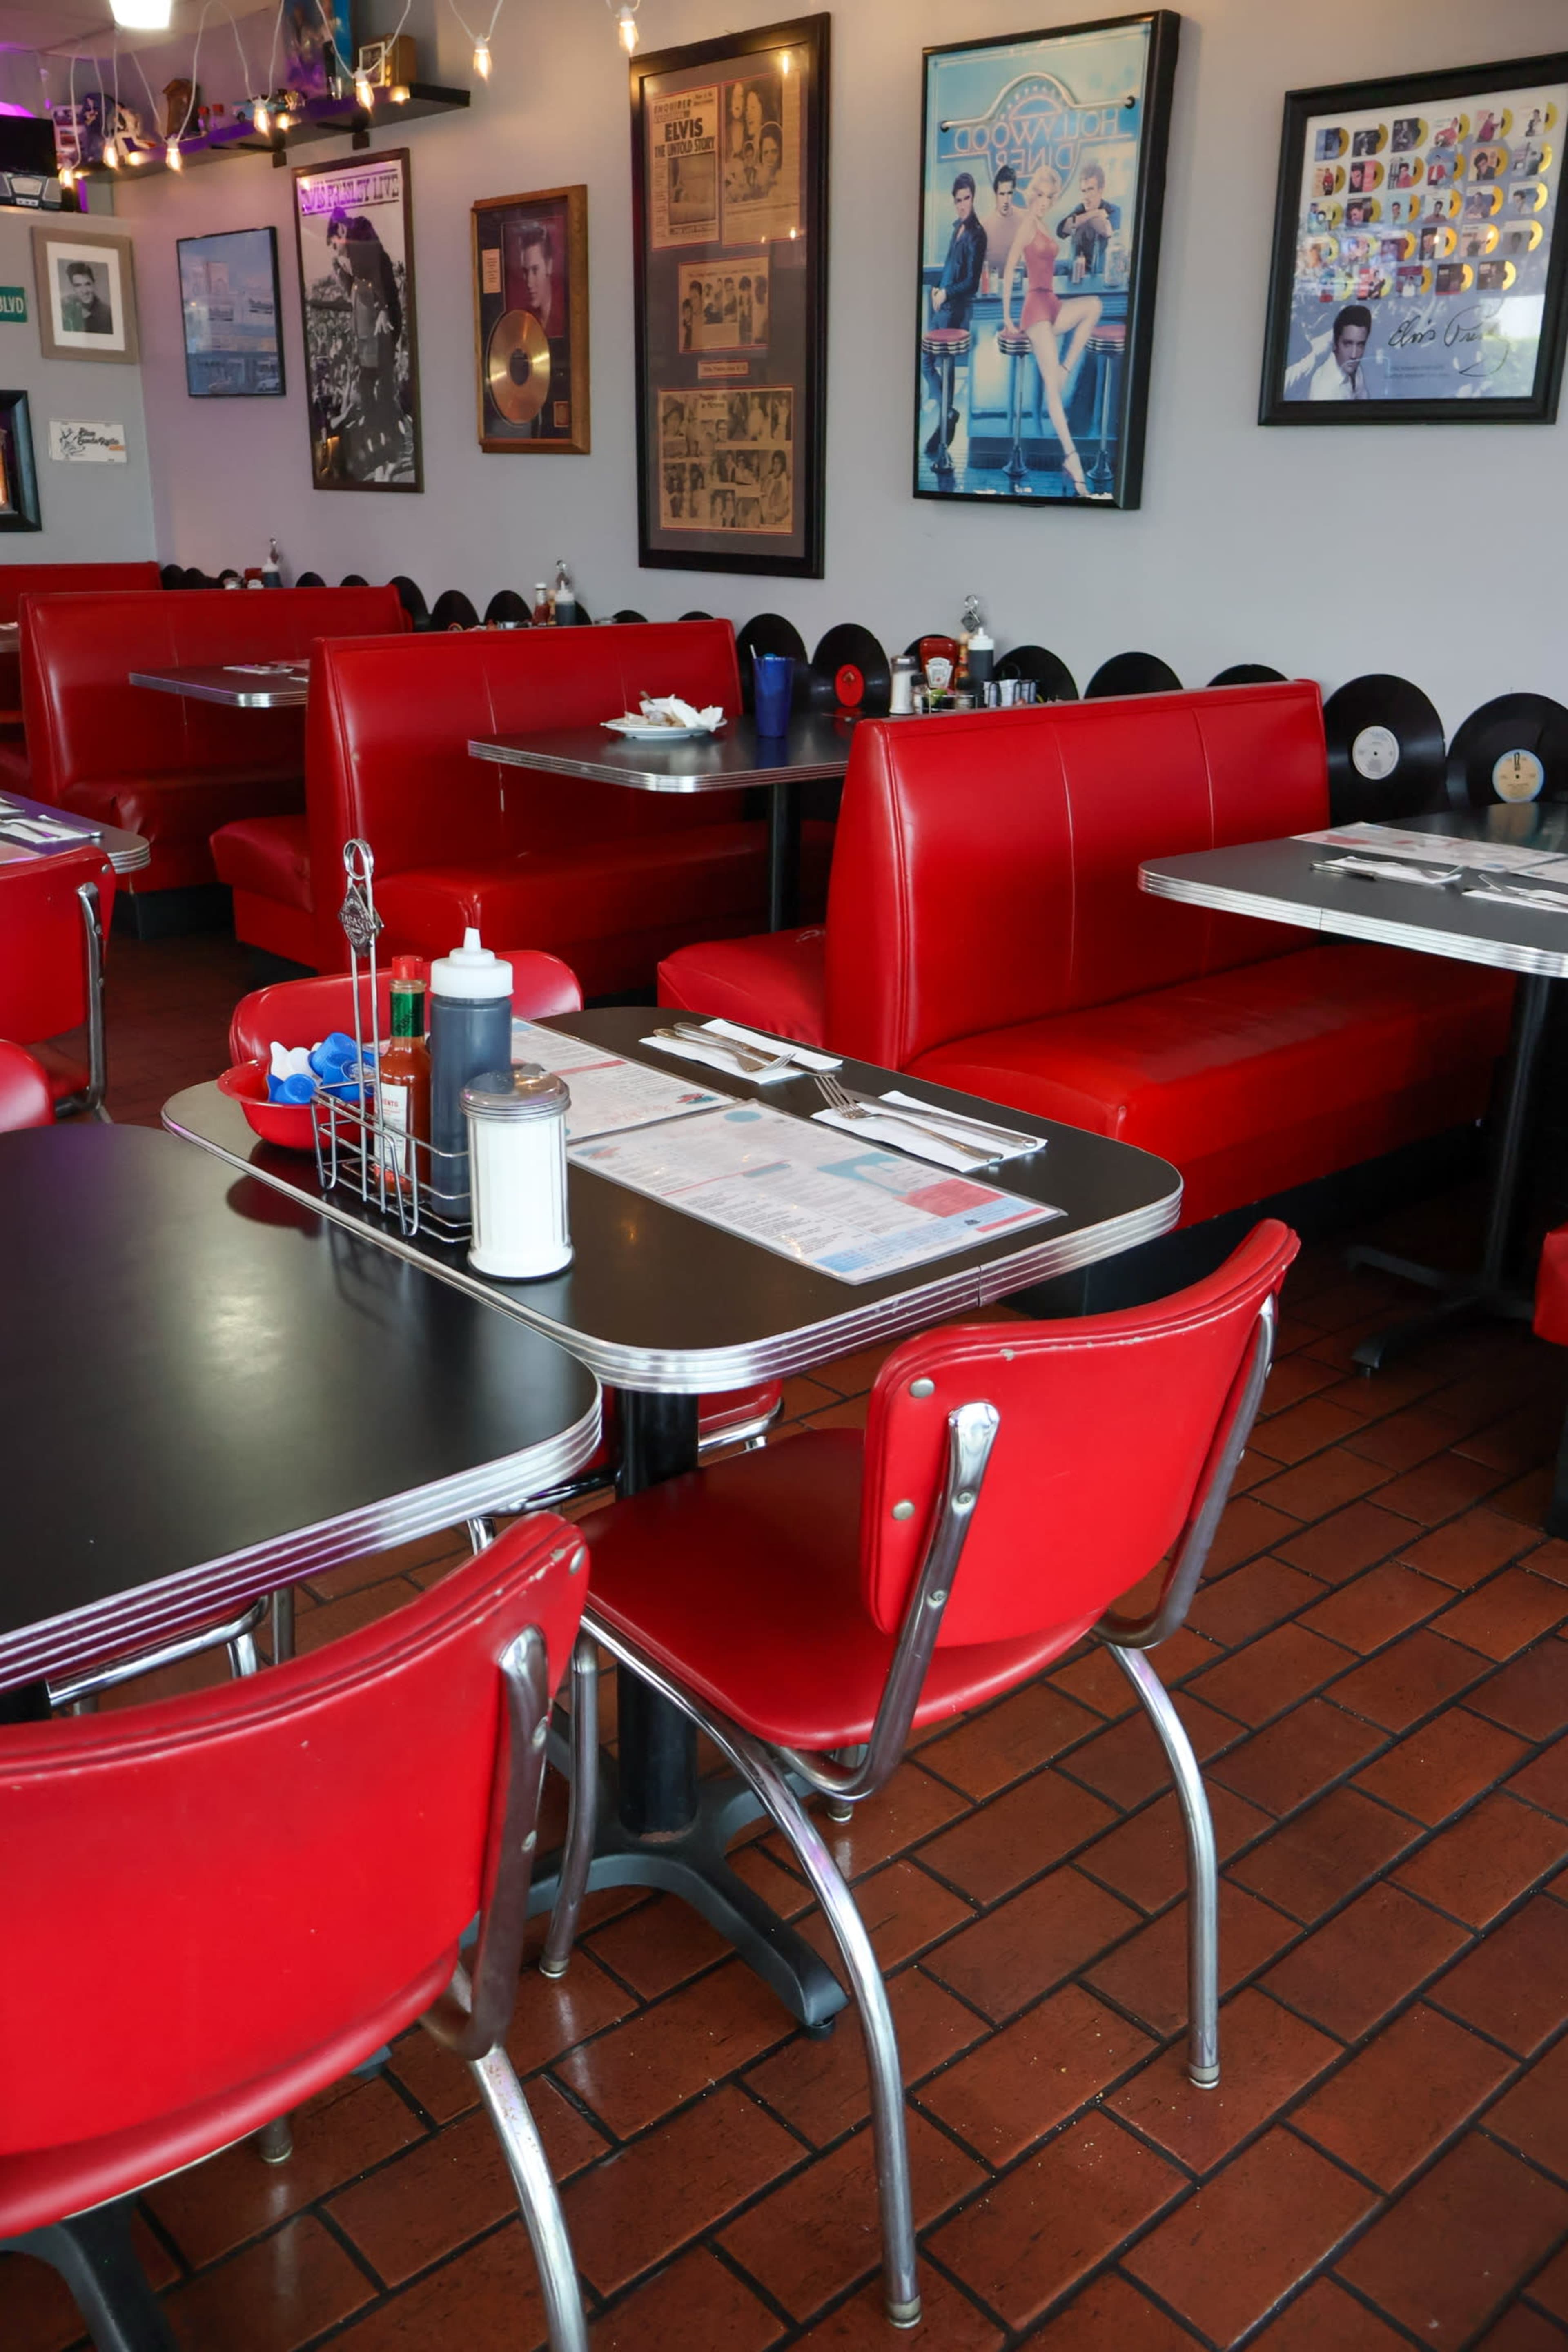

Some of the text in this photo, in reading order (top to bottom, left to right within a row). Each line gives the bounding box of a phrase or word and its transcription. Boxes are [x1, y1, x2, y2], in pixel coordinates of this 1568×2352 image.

[665, 117, 703, 142] ELVIS
[655, 136, 715, 158] THE UNTOLD STORY
[373, 173, 399, 200] LIVE
[1388, 314, 1436, 347] Elvis
